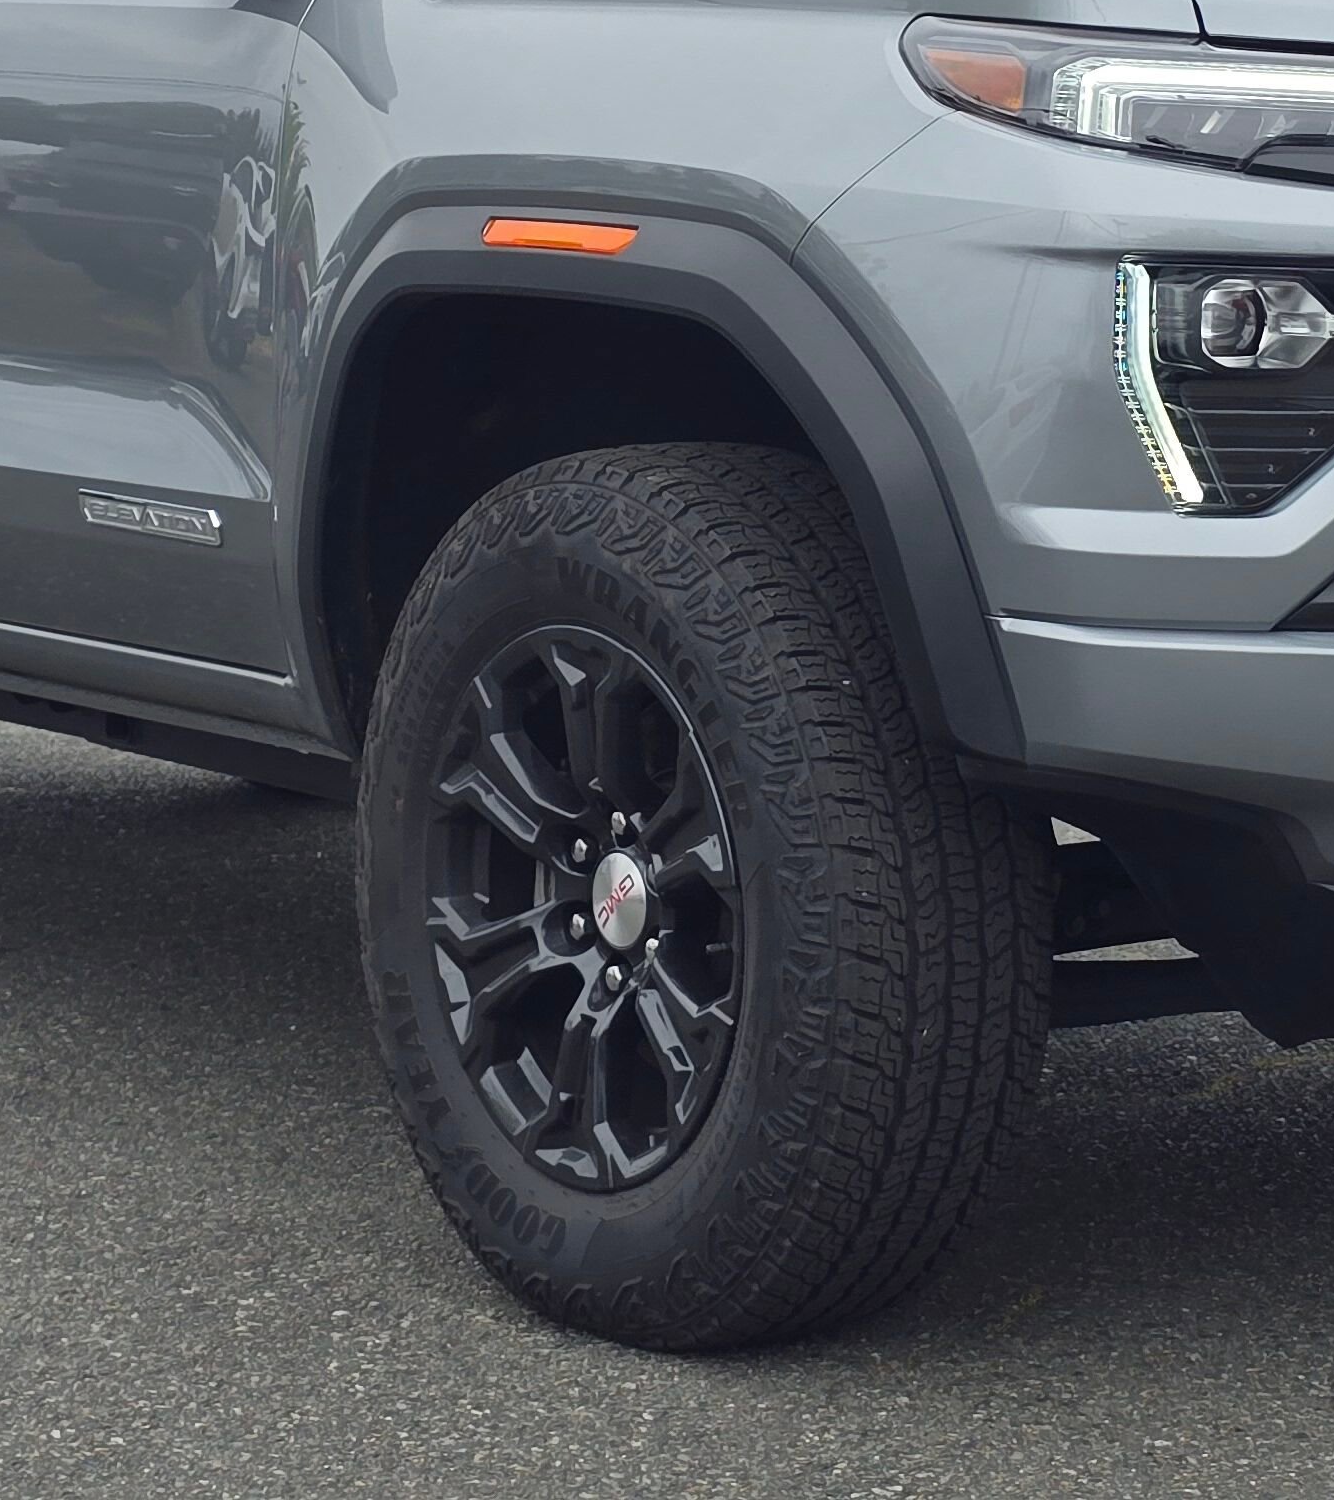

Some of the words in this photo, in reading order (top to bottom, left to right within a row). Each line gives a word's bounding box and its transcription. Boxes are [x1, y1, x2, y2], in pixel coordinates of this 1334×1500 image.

[91, 501, 208, 534] ELEVATION
[556, 556, 753, 832] WRANGLER
[597, 873, 635, 930] GMC
